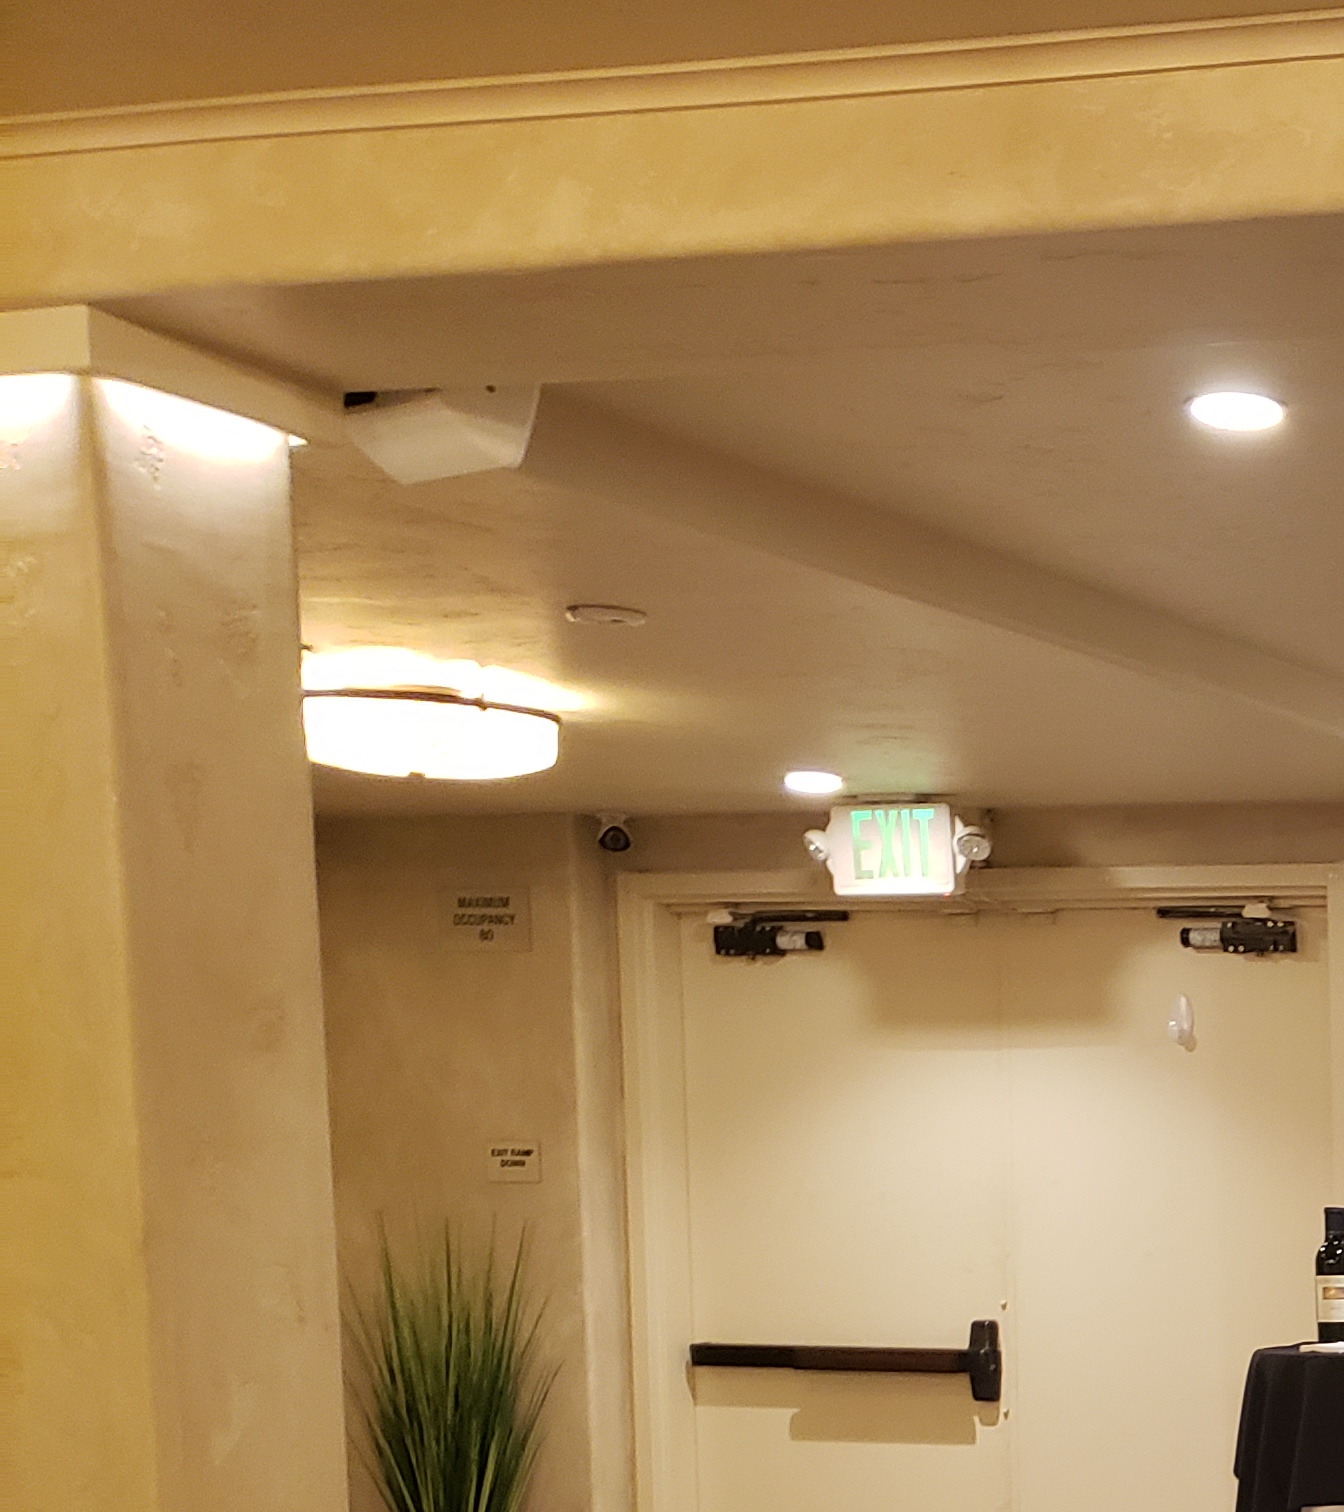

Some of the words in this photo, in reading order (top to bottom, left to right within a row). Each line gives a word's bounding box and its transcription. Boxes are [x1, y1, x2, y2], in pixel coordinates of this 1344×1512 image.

[850, 808, 935, 880] EXIT
[457, 896, 510, 908] MAXIMUM
[453, 913, 516, 926] OCCUPANCY
